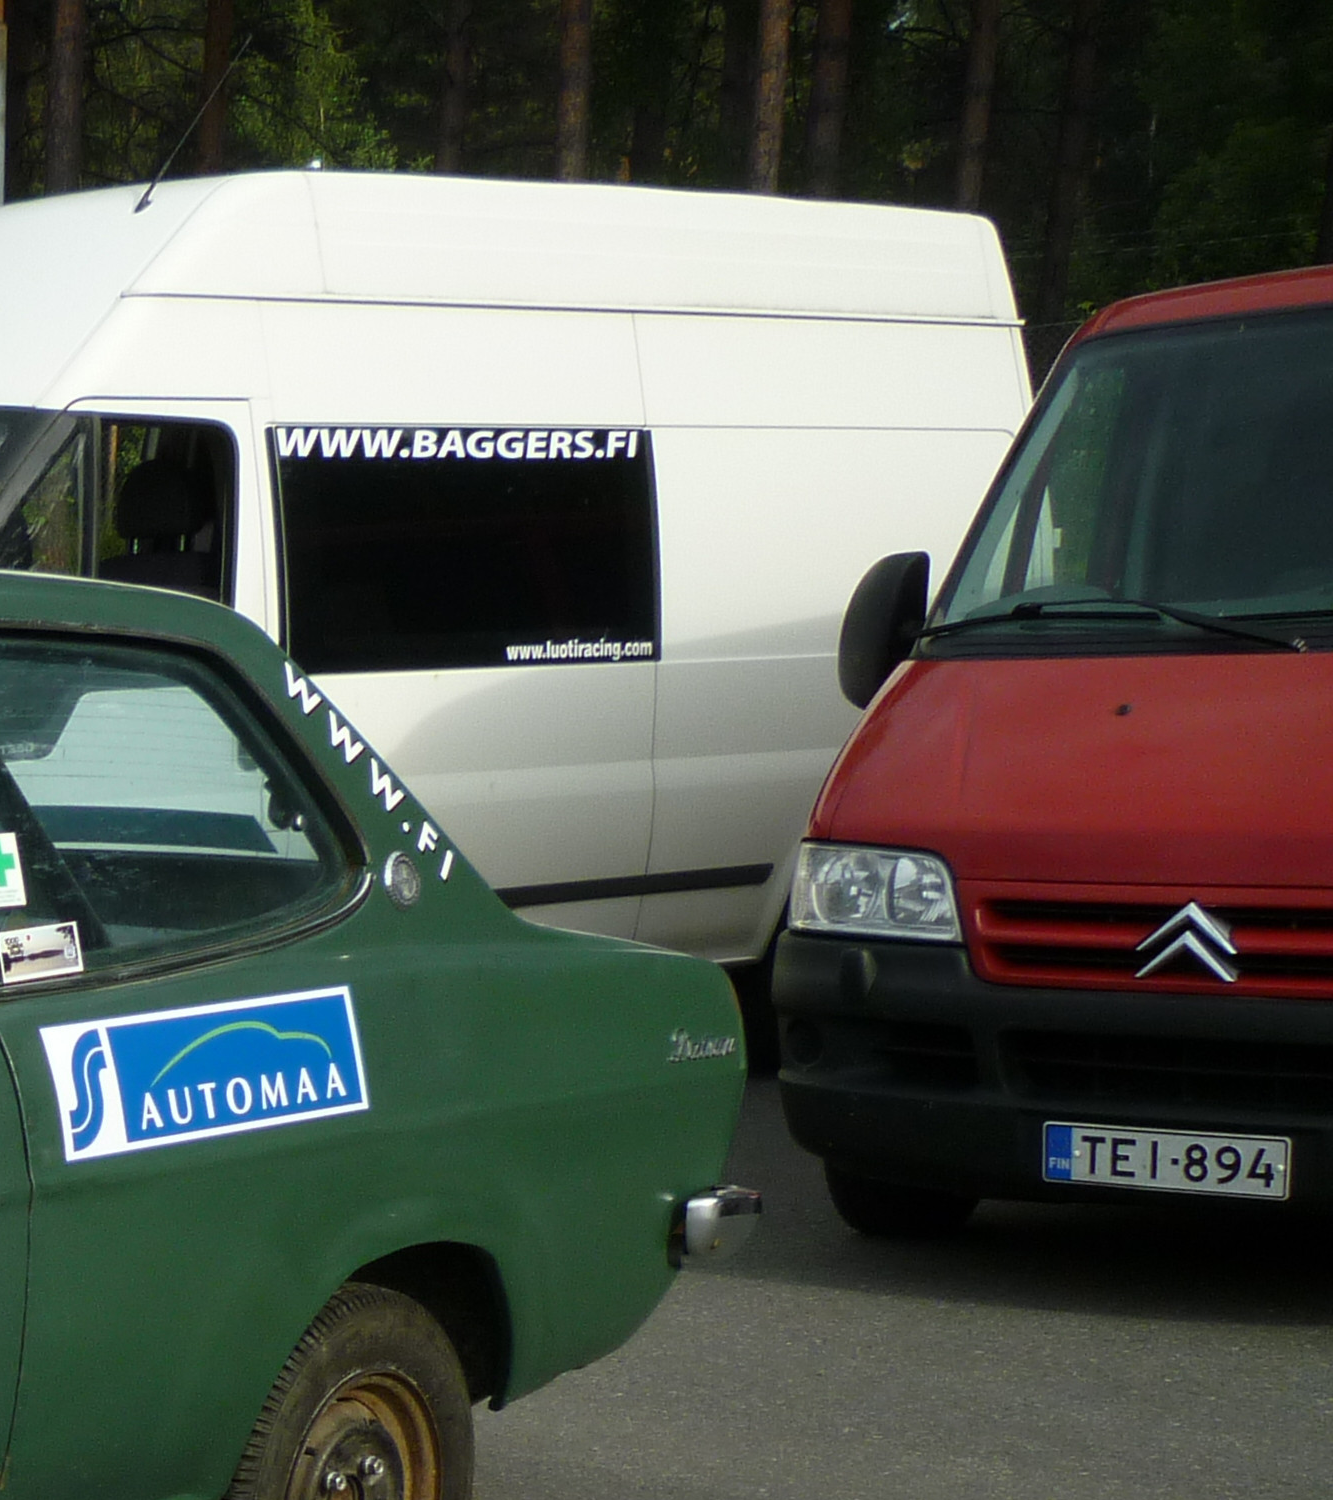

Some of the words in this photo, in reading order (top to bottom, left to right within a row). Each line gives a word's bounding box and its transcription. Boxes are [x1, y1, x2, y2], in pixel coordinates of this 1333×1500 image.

[276, 427, 639, 460] WWW.BAGGERS.FI
[506, 638, 653, 661] www.luotiracing.com
[141, 1062, 348, 1131] AUTOMAA
[1048, 1156, 1071, 1170] FIN
[1081, 1135, 1275, 1189] TEI-894
